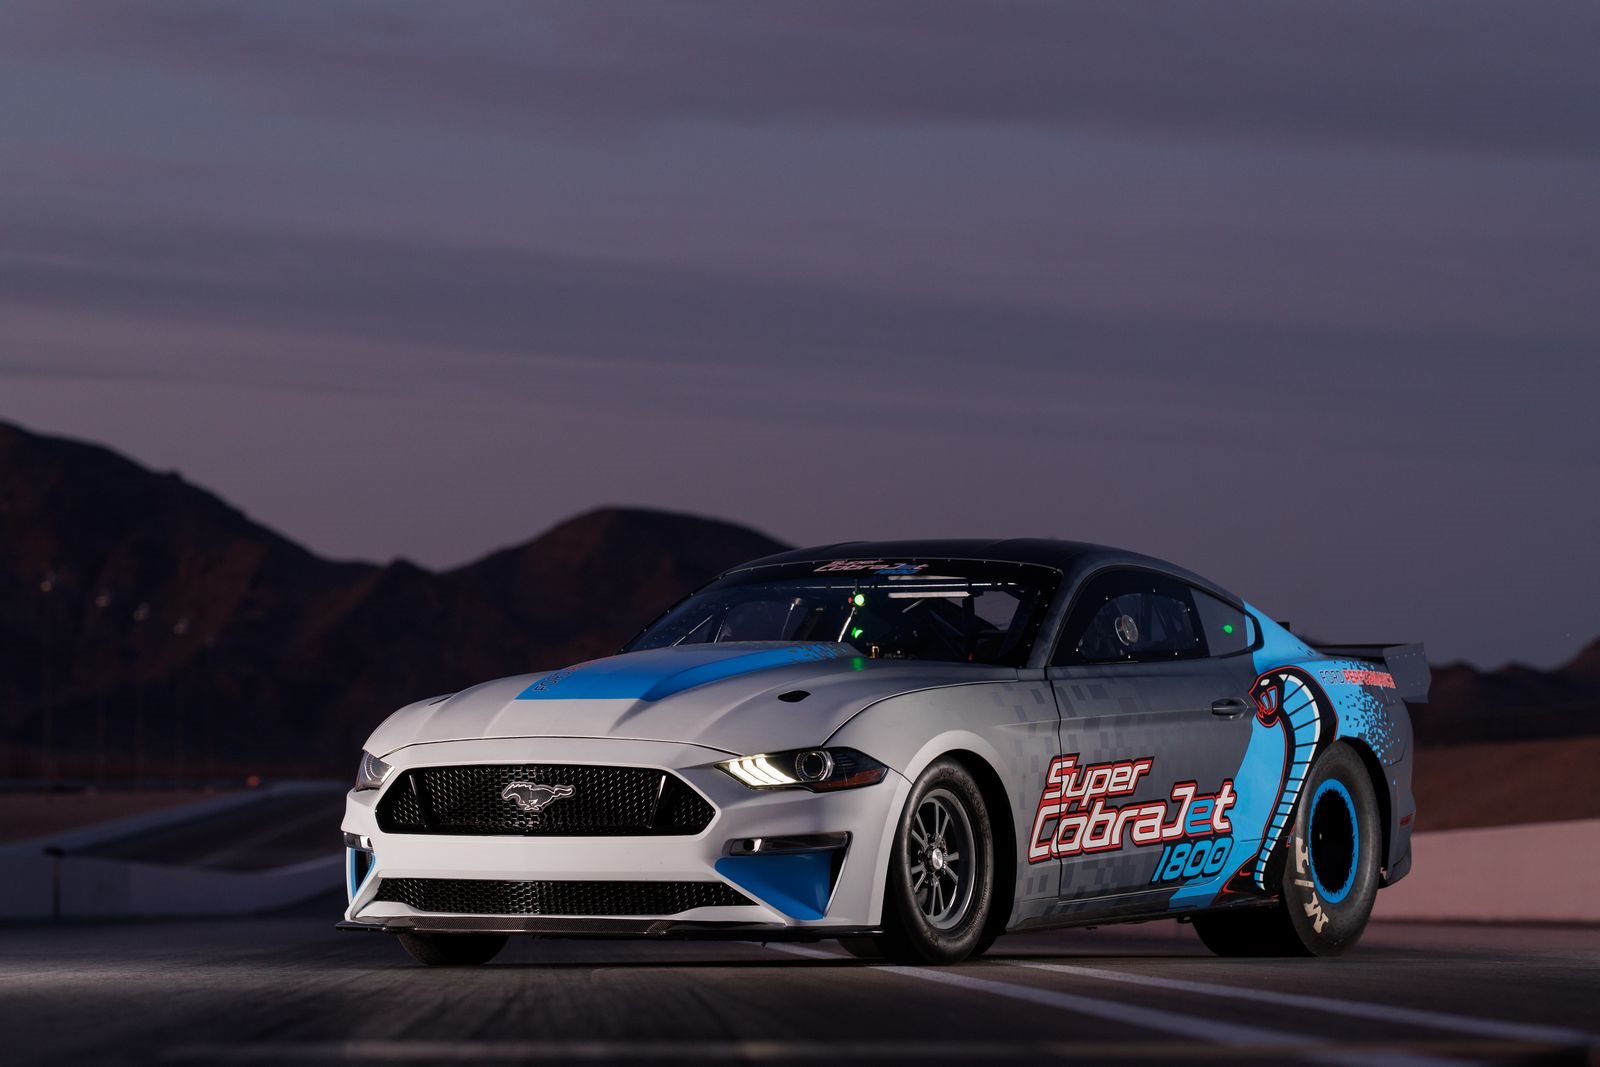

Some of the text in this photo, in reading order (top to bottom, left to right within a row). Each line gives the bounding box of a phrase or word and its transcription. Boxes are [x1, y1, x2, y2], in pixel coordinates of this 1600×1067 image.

[1042, 753, 1154, 809] Super
[1028, 779, 1237, 864] CobraJet
[1149, 836, 1235, 885] 1800
